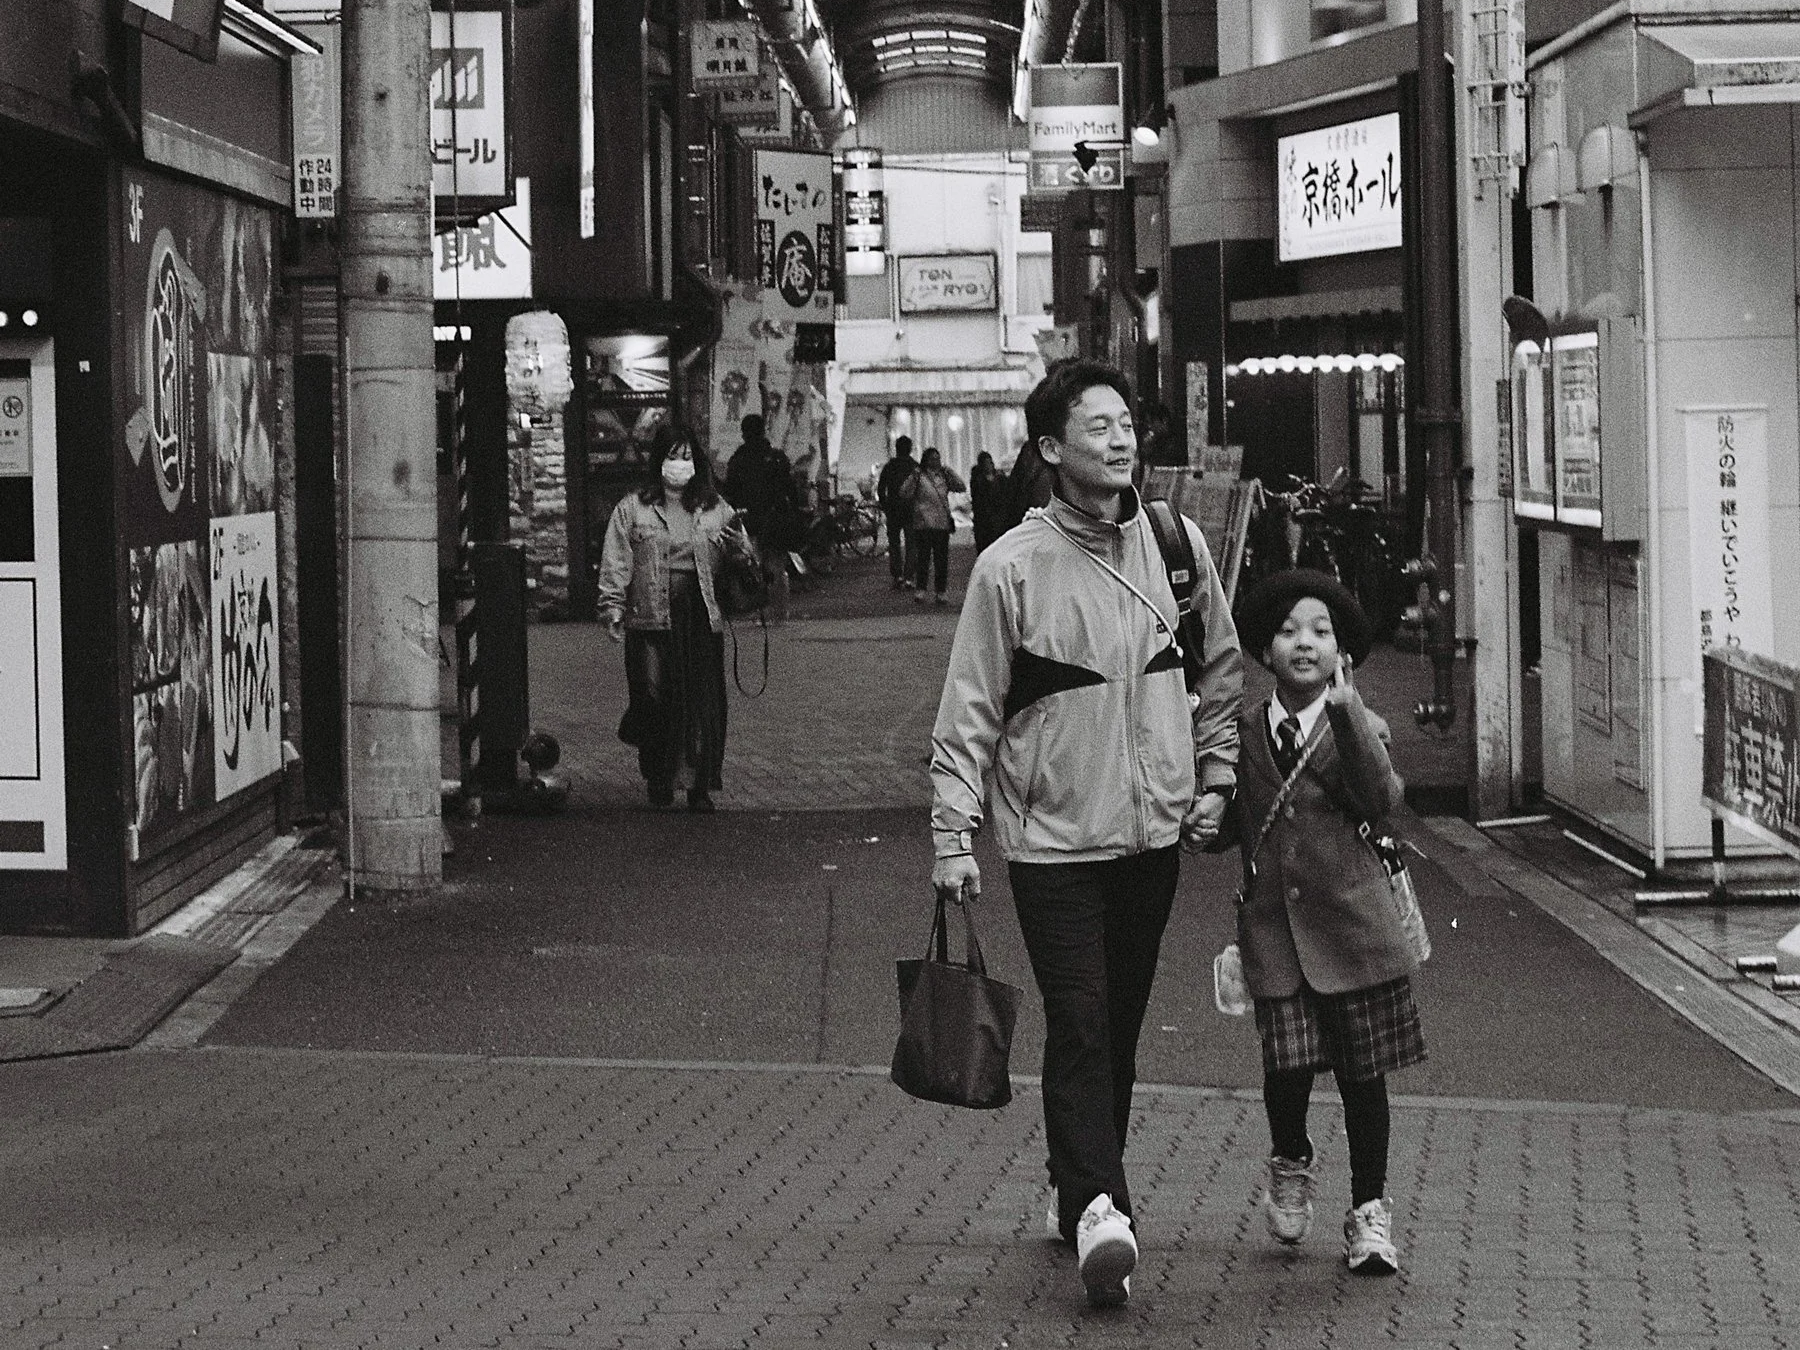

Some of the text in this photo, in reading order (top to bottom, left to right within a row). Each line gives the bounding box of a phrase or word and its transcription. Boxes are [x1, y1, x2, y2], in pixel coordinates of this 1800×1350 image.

[1034, 120, 1118, 139] FamilyMart
[128, 181, 143, 244] 3F
[1301, 151, 1401, 228] 京橋ホール
[212, 526, 224, 581] 2F
